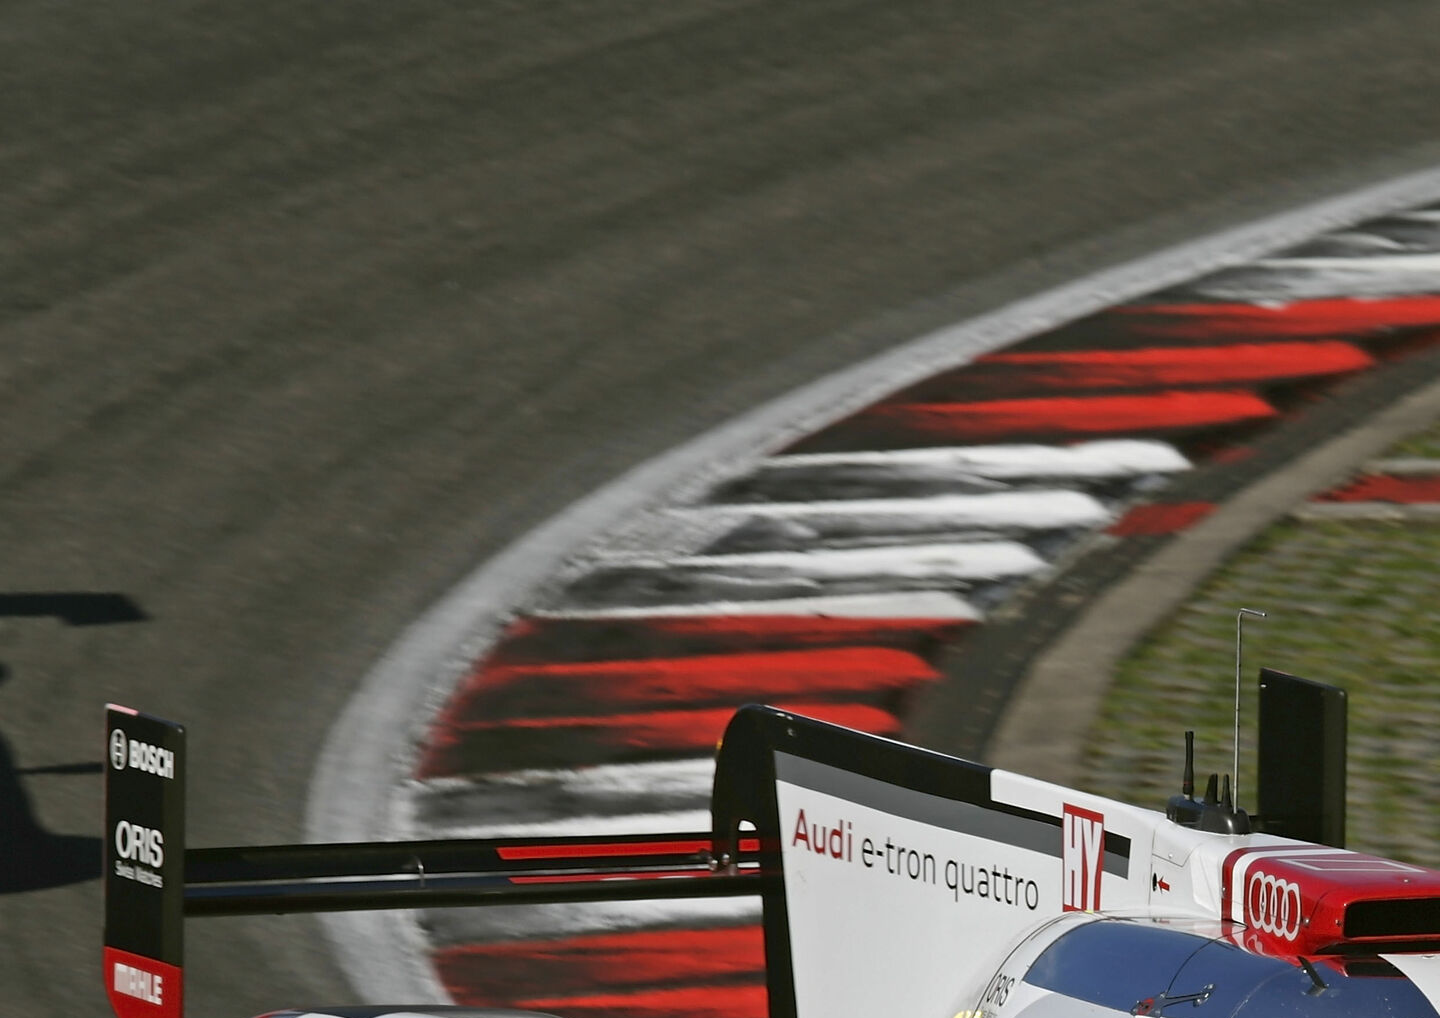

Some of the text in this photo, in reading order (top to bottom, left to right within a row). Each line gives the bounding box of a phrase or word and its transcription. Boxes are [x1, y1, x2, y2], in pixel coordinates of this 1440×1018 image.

[128, 739, 175, 780] BOSCH
[115, 820, 164, 868] ORIS
[793, 809, 1039, 911] Audi e-tron quattro
[1064, 813, 1102, 911] HY
